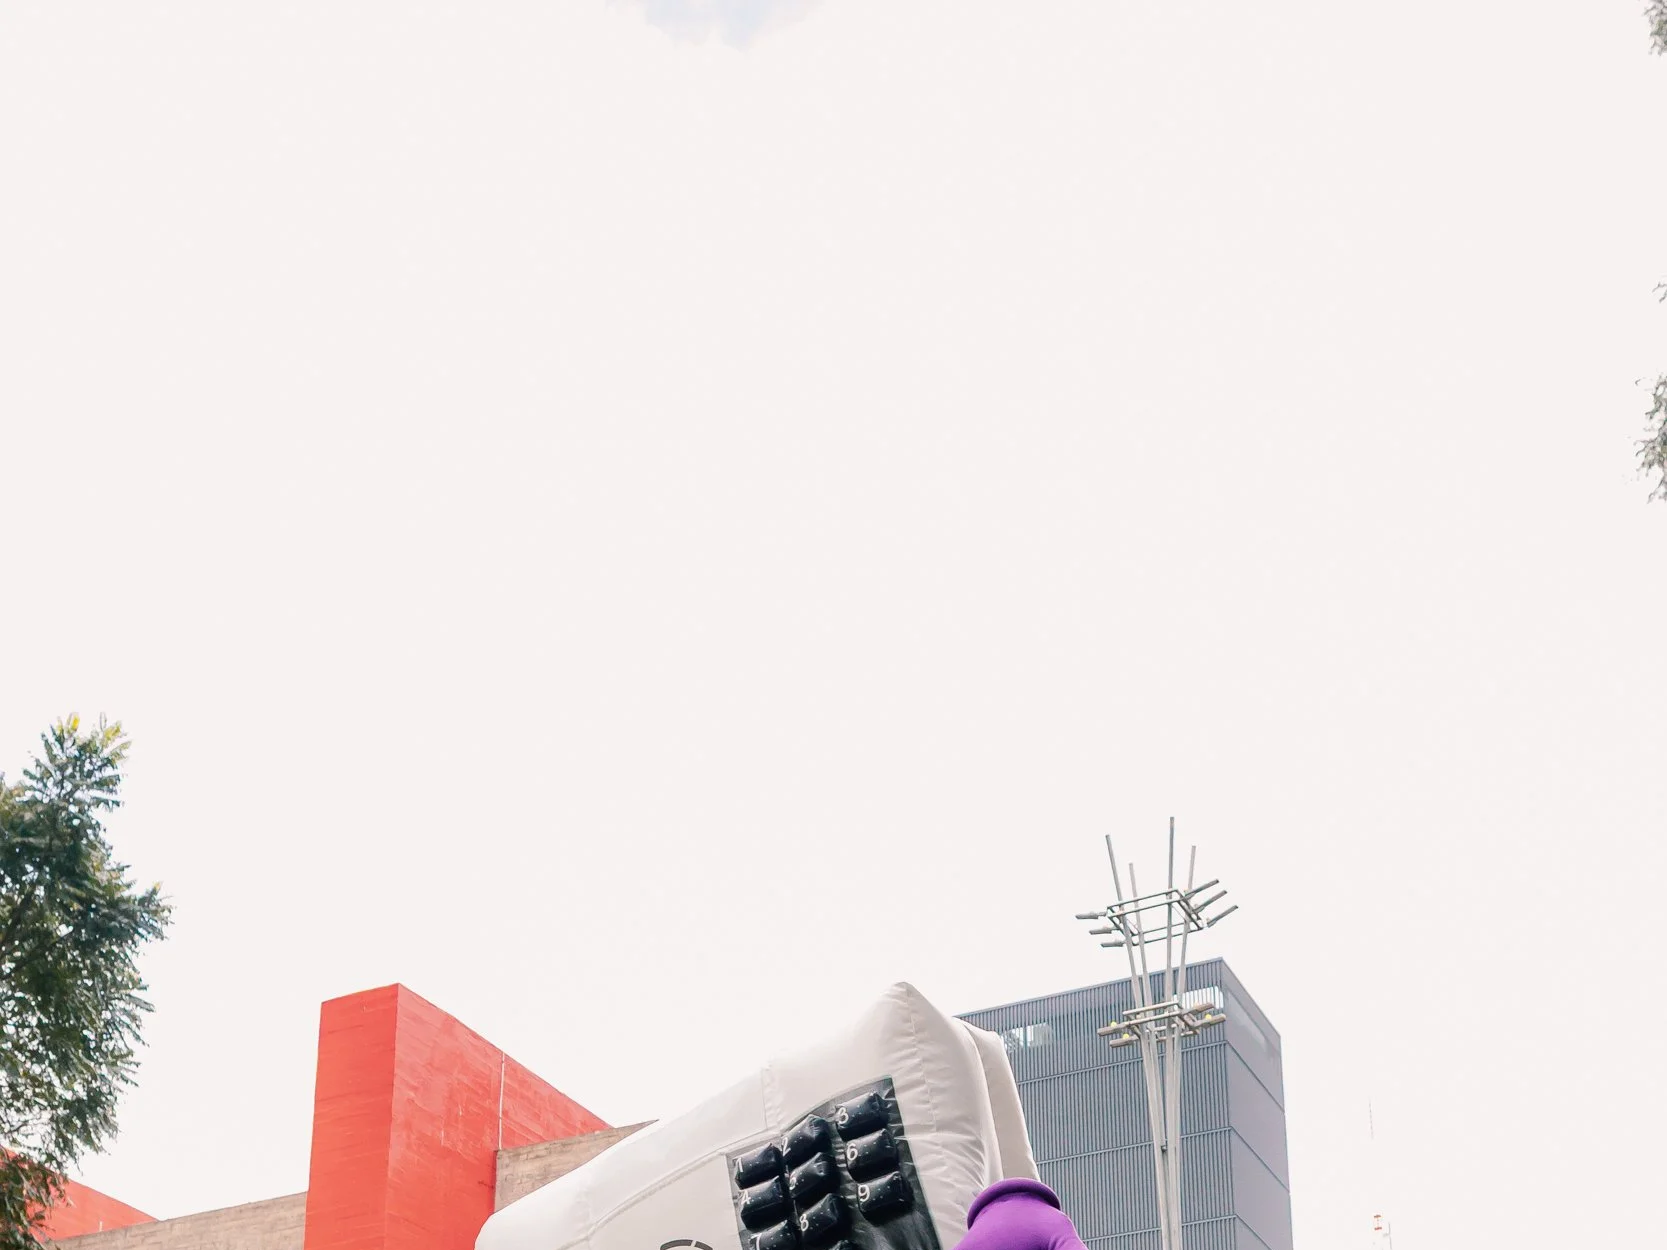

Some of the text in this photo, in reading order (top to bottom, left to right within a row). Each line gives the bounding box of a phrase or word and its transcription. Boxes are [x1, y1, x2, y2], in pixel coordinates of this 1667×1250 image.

[781, 1136, 792, 1157] 2
[846, 1142, 859, 1161] 6
[735, 1156, 744, 1173] 1
[740, 1189, 752, 1205] 4
[857, 1184, 870, 1203] 9
[799, 1213, 809, 1232] 8
